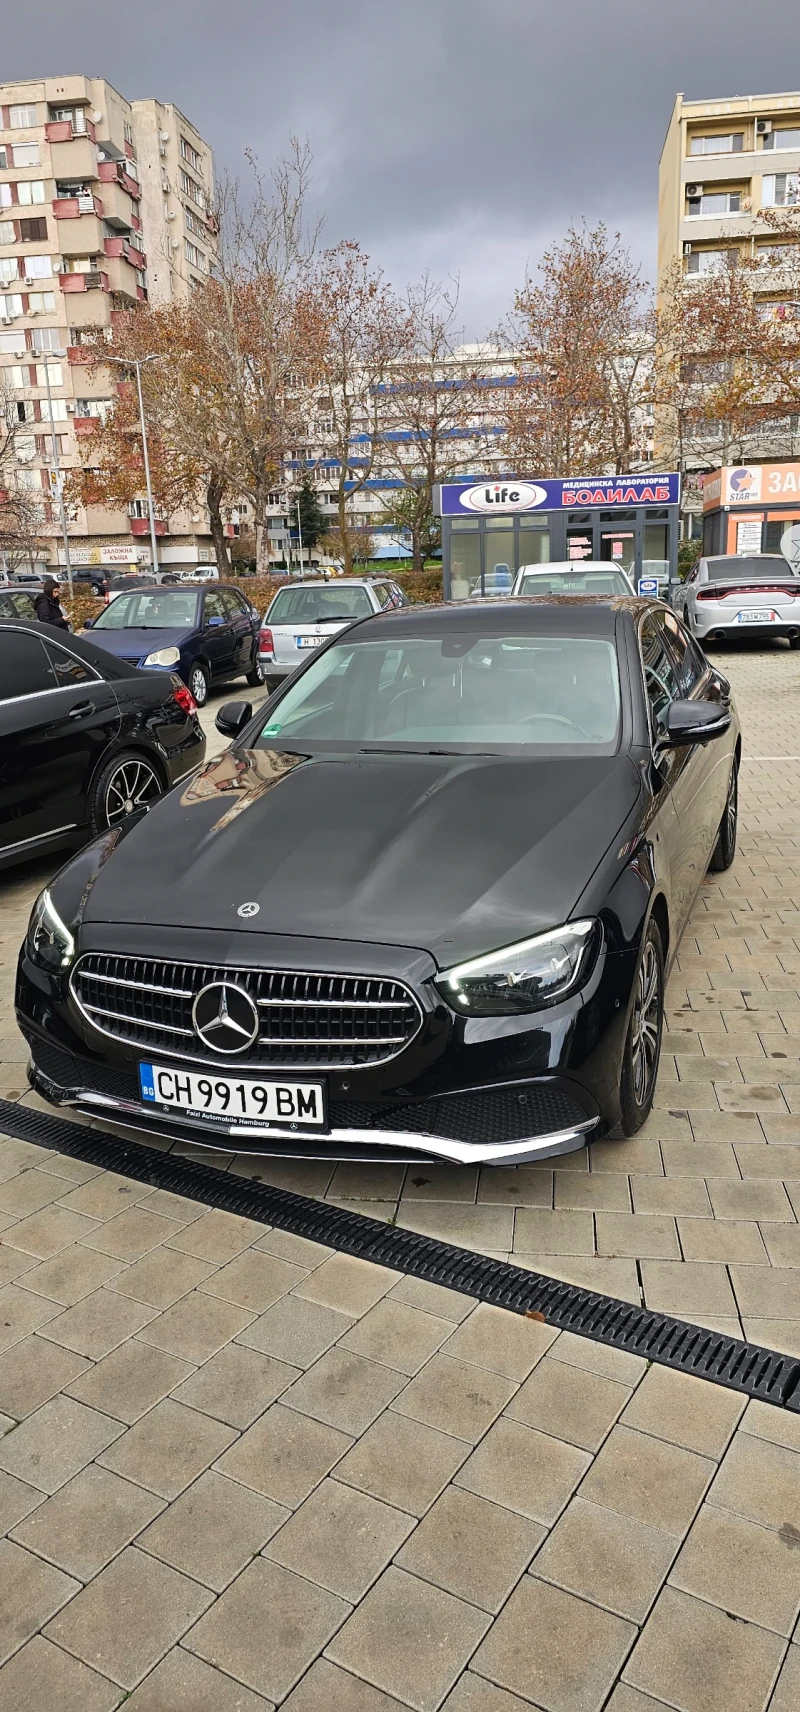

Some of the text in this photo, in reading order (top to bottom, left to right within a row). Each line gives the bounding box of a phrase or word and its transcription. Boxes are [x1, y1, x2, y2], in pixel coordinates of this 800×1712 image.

[562, 477, 669, 489] МЕДИЦИНСКА ЛАБОРАТОРИЯ
[768, 470, 800, 494] ЗА
[485, 486, 520, 504] Life
[562, 486, 670, 506] БОДИЛАБ
[729, 492, 750, 501] STAR
[143, 1086, 154, 1096] BG
[201, 1112, 237, 1124] Automobile
[238, 1118, 270, 1127] Hamburg
